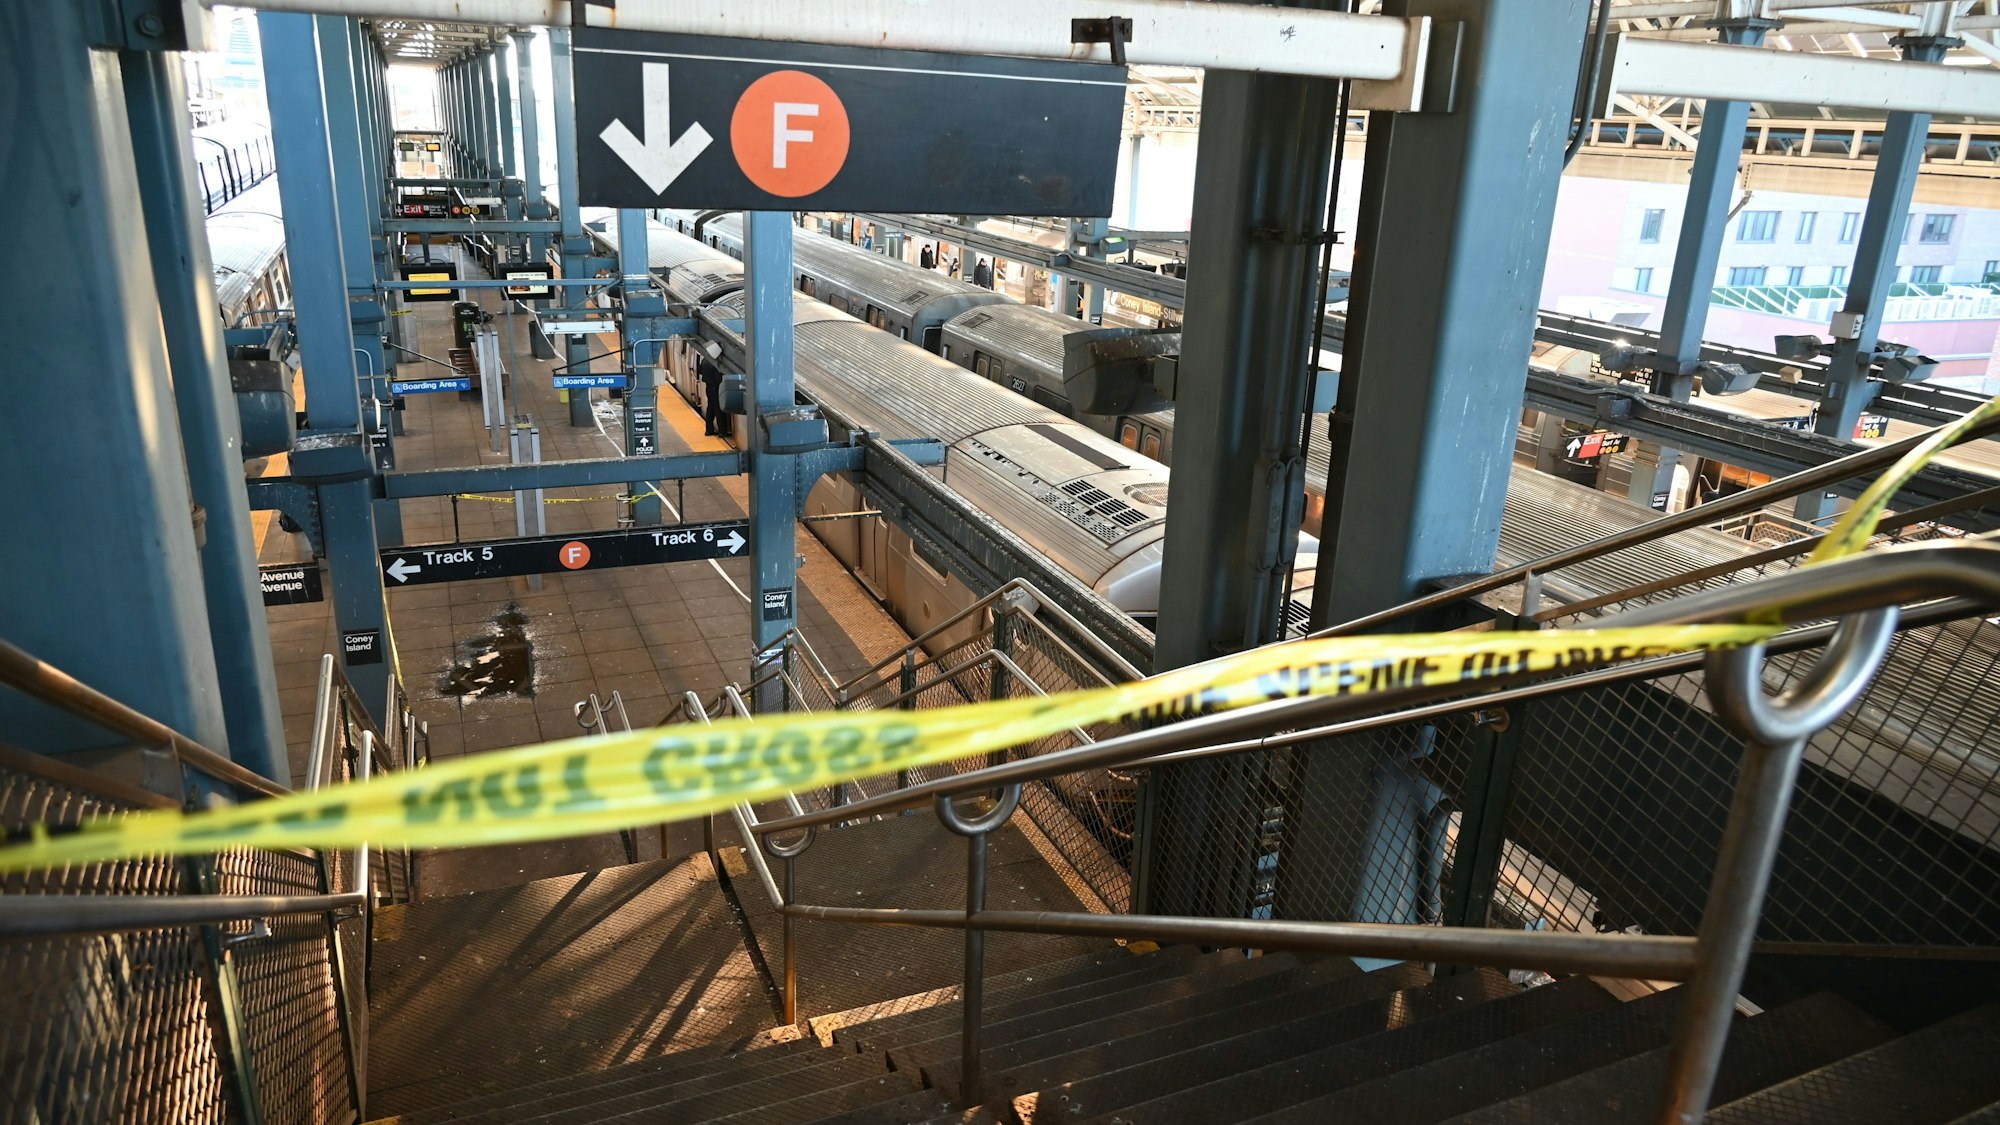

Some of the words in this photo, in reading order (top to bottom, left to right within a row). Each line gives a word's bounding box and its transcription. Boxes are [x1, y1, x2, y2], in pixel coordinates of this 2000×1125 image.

[772, 102, 820, 169] F
[404, 205, 422, 214] Exit
[1120, 295, 1140, 313] Coney
[1611, 370, 1622, 379] End
[402, 381, 437, 391] Boarding
[439, 380, 457, 389] Area
[563, 377, 596, 386] Boarding
[1584, 435, 1602, 445] Exit
[652, 531, 697, 547] Track
[703, 528, 714, 543] 6
[423, 549, 475, 566] Track
[481, 547, 494, 561] 5
[568, 548, 582, 564] F
[261, 570, 304, 582] Avenue
[261, 581, 303, 593] Avenue
[764, 593, 788, 602] Coney
[764, 600, 785, 609] Island
[345, 634, 374, 644] Coney
[346, 643, 372, 652] Island
